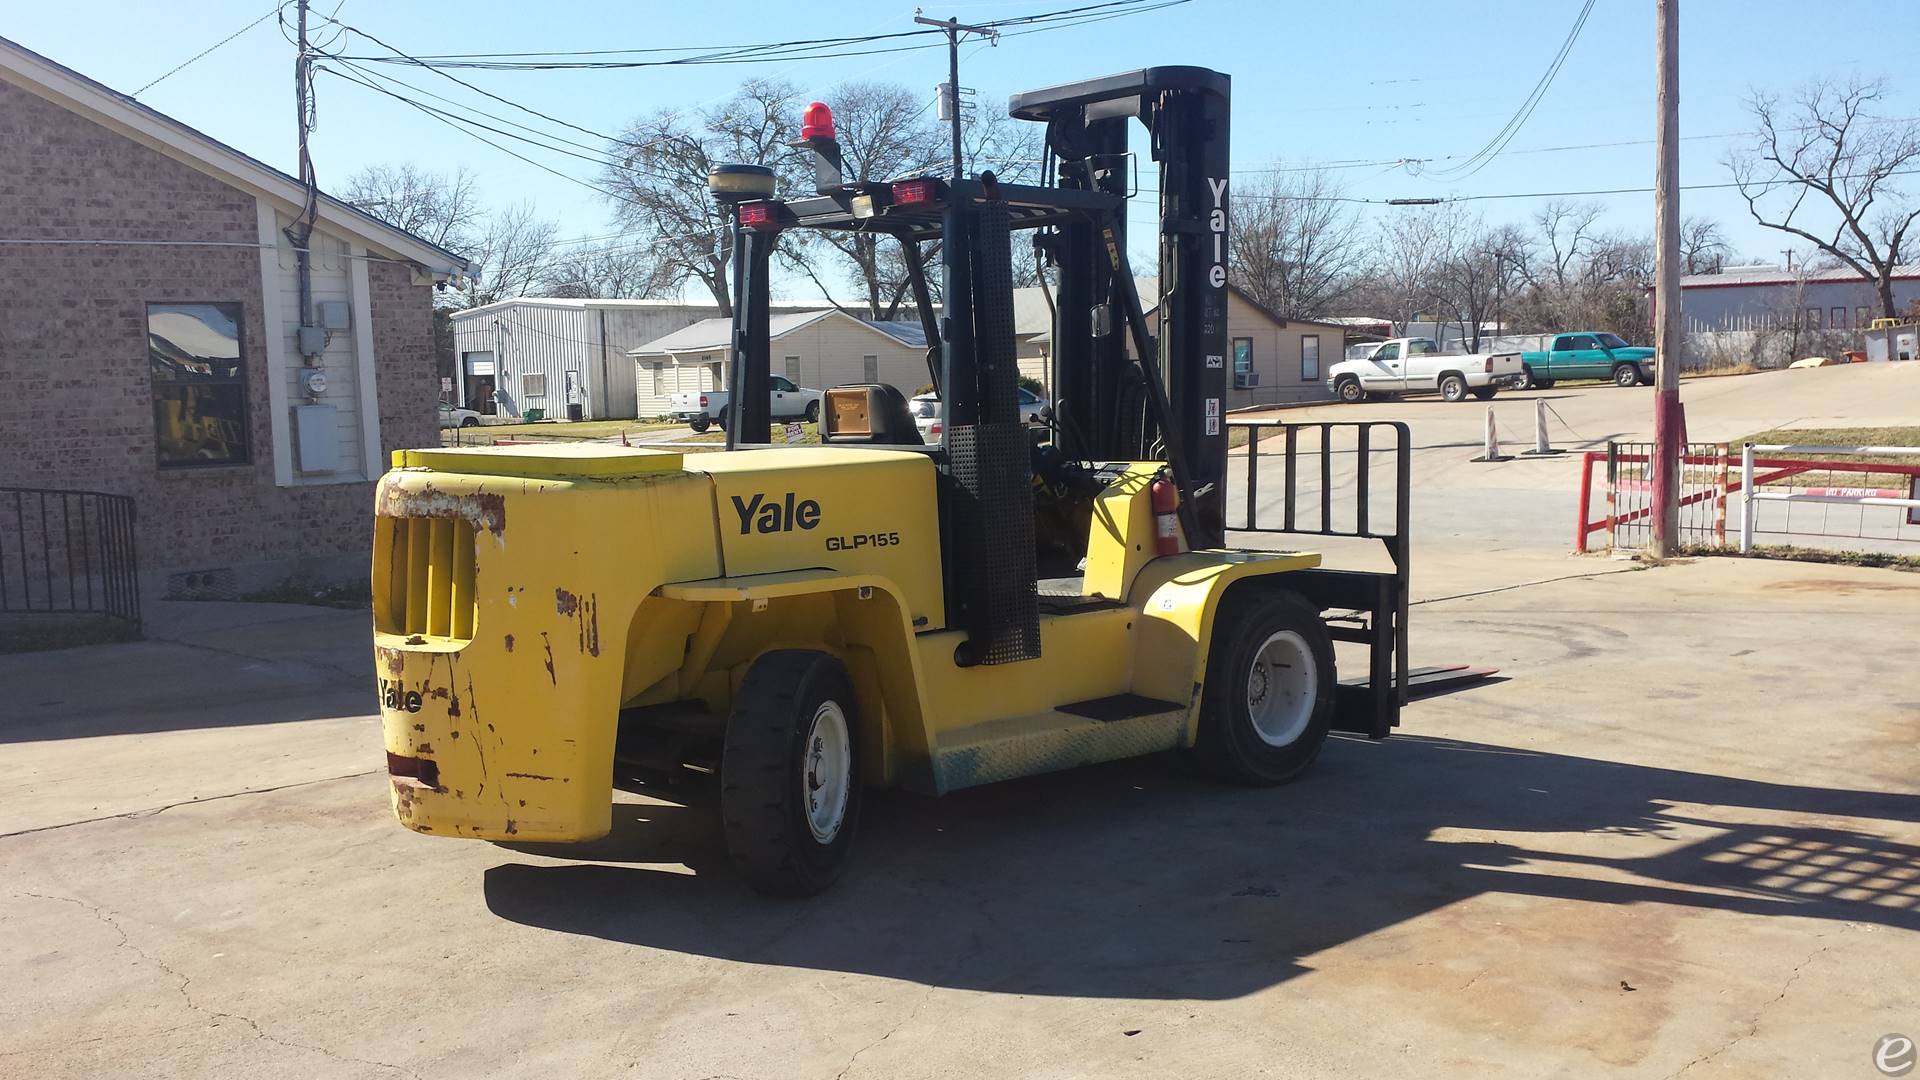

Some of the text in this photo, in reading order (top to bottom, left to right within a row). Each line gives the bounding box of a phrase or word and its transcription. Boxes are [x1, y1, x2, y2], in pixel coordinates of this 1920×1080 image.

[1208, 177, 1227, 288] Yale
[1840, 487, 1878, 497] PARKING
[731, 492, 821, 535] Yale
[825, 532, 900, 551] GLP155
[379, 677, 423, 714] Yale
